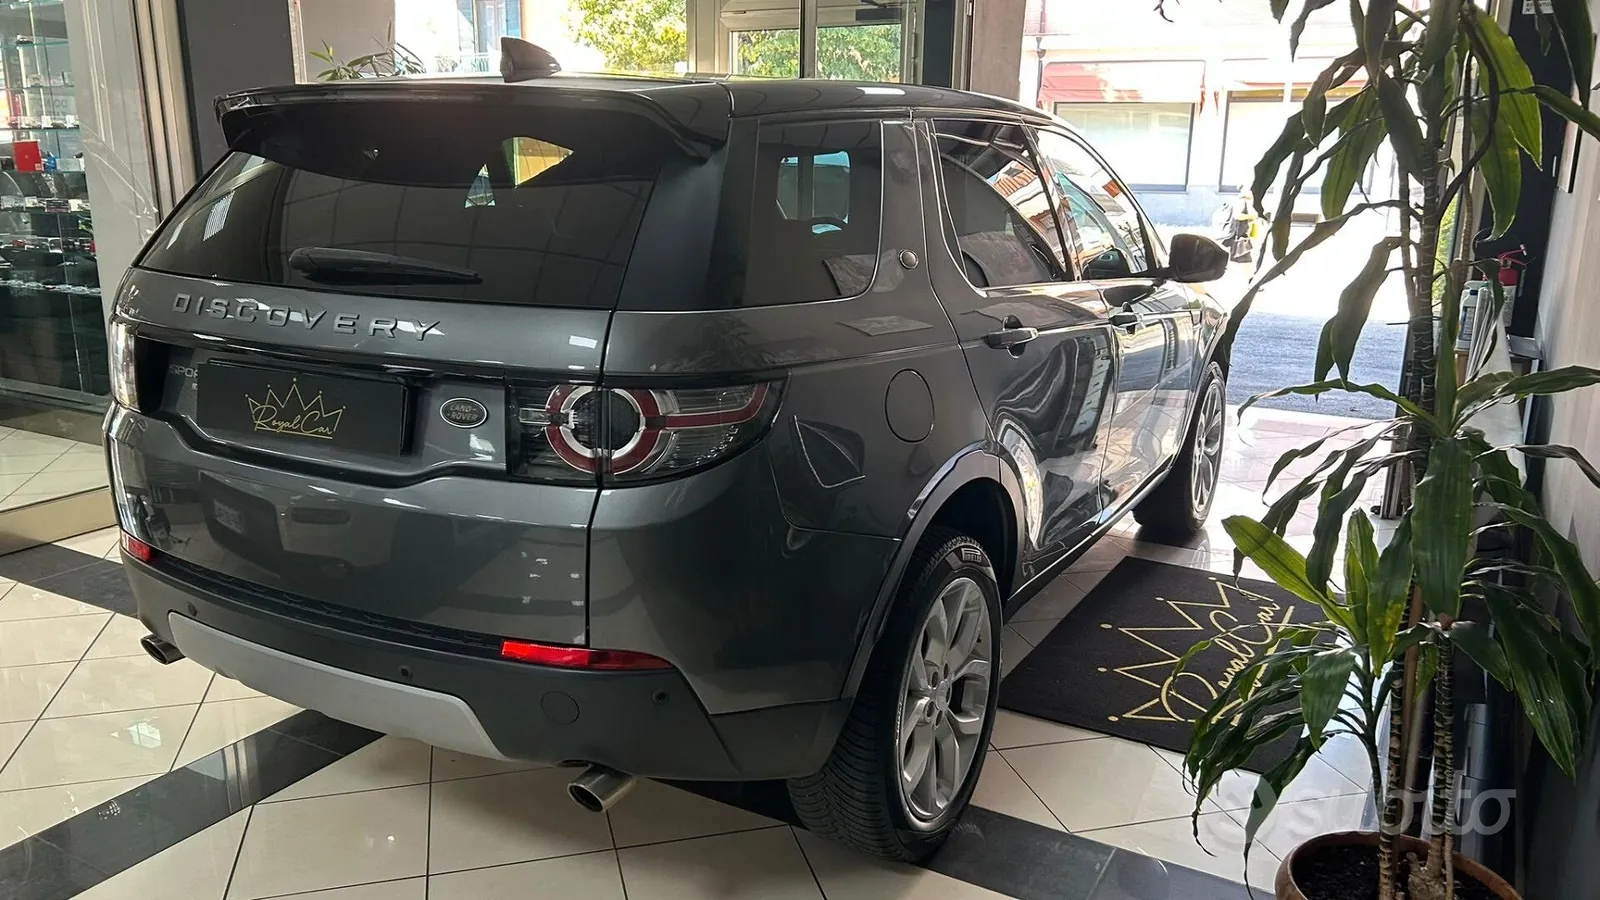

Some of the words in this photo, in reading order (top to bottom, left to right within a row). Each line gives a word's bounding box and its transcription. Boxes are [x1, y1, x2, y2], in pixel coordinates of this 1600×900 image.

[172, 293, 441, 341] DISCOVERY
[253, 404, 301, 433] Royal
[301, 410, 332, 435] Car
[1209, 602, 1281, 646] Car
